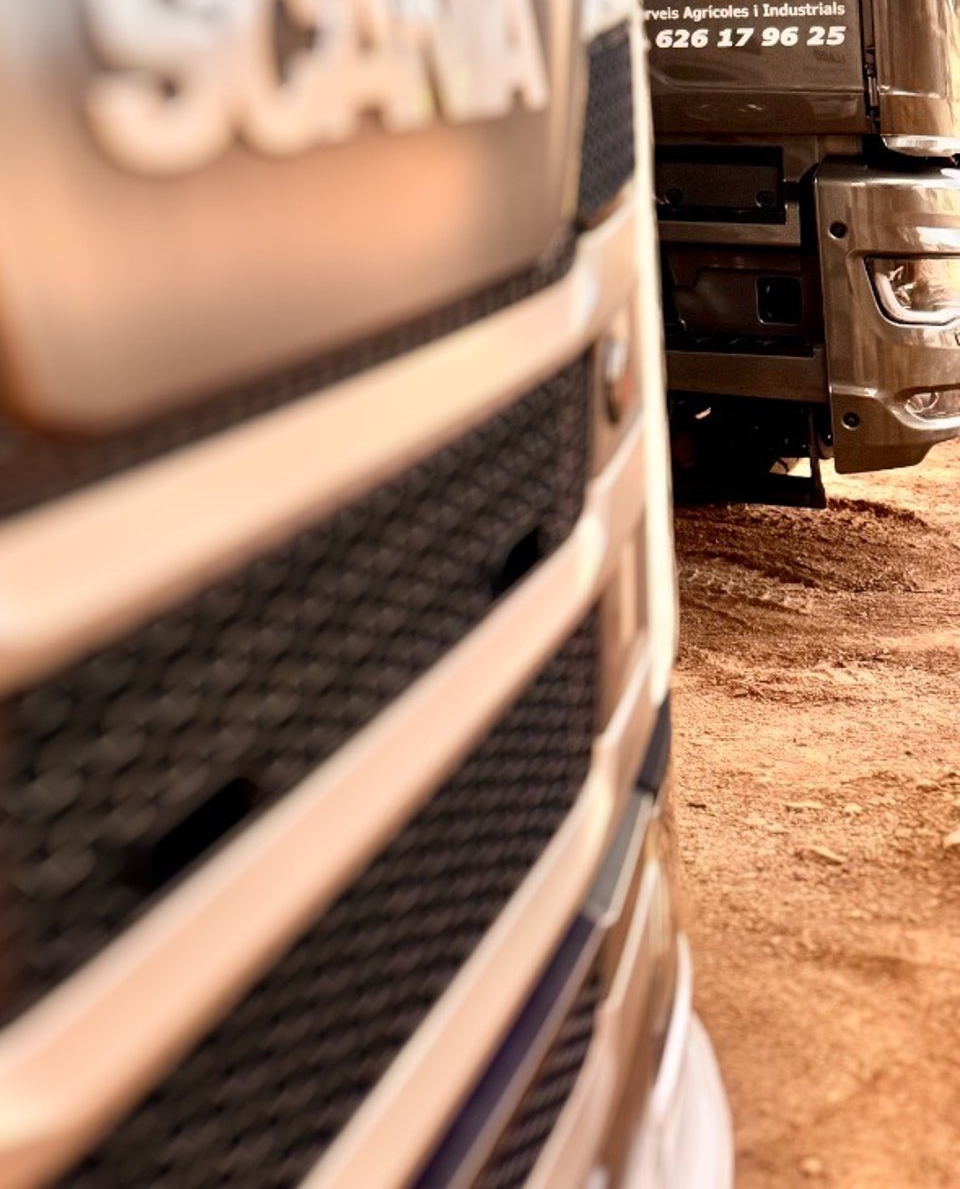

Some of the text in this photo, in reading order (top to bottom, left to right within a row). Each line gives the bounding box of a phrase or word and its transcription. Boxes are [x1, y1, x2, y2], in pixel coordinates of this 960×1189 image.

[643, 1, 846, 23] rveis Agrícoles i Industrials
[655, 25, 847, 49] 626 17 96 25
